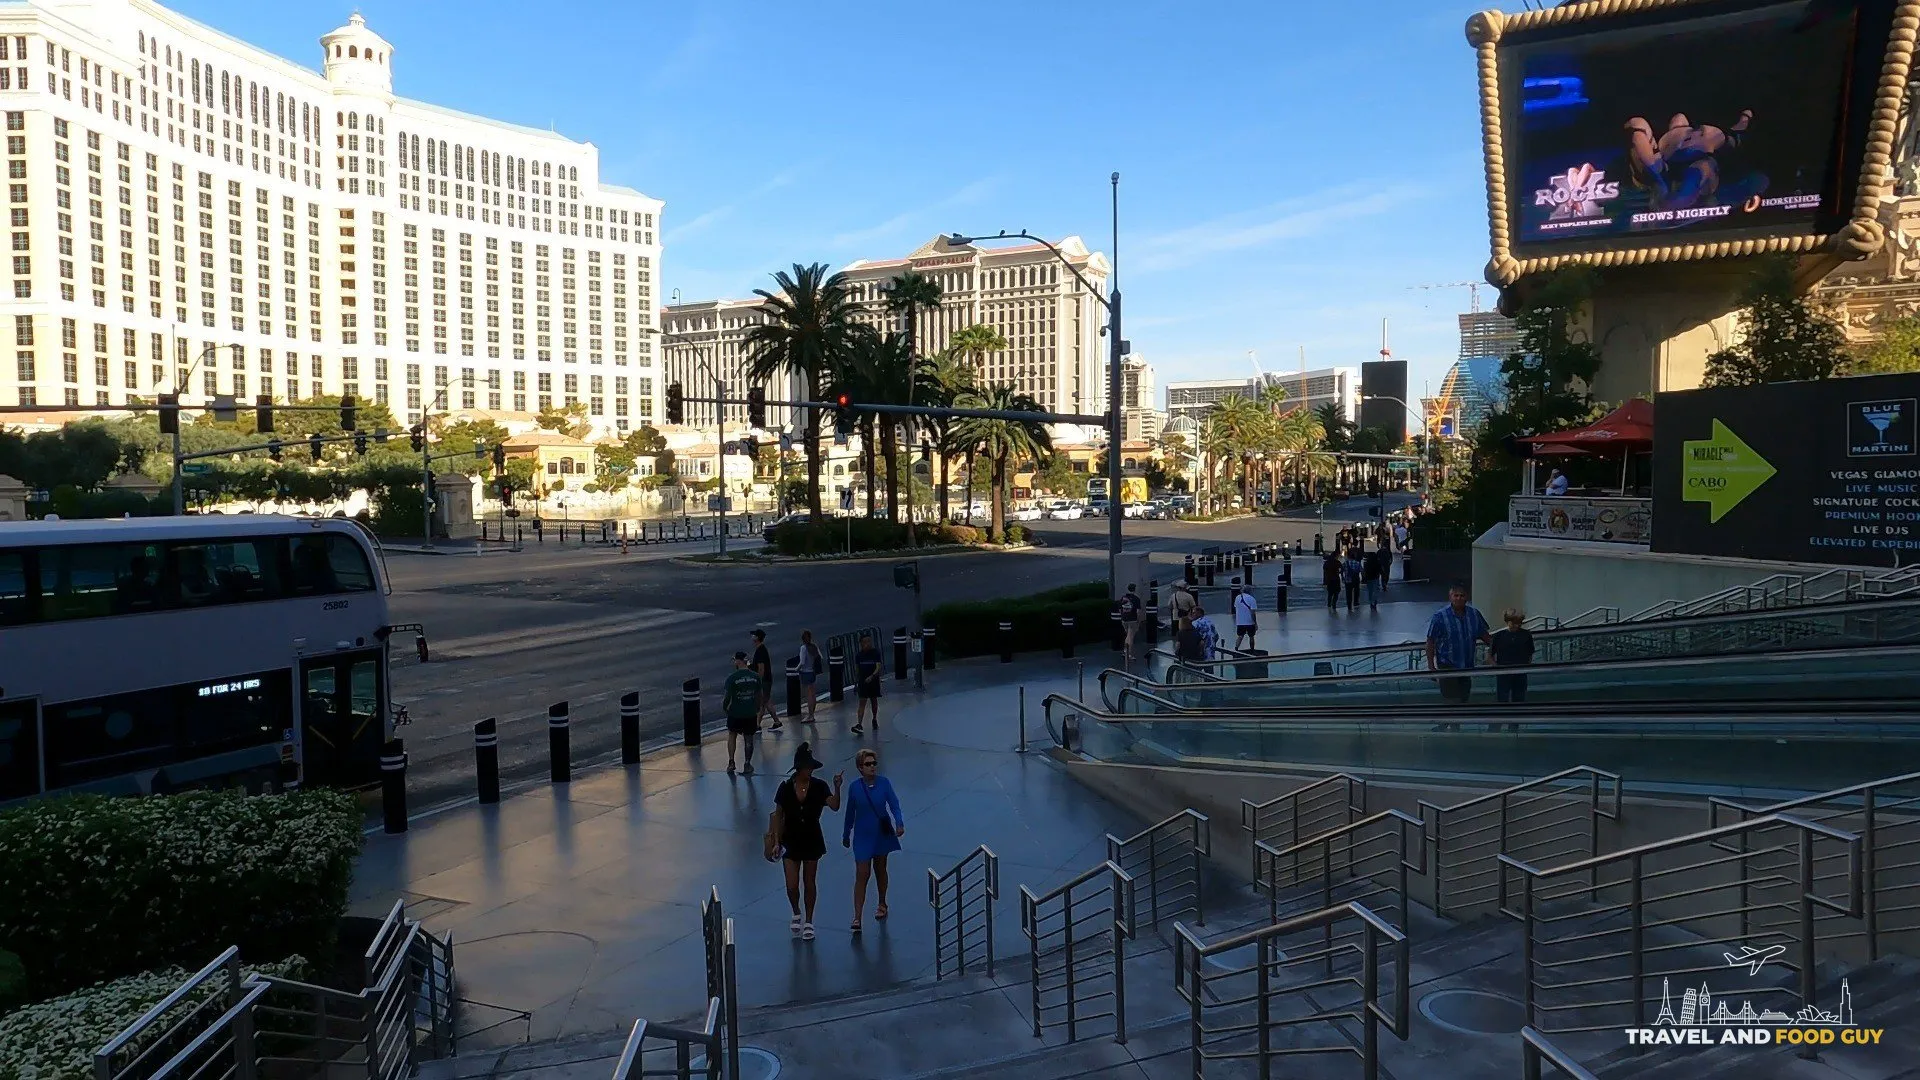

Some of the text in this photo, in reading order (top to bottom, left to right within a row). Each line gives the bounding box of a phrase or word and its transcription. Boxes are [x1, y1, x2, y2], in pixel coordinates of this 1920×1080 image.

[1535, 181, 1620, 206] ROCKS
[1761, 194, 1821, 207] HORSESHOE
[1632, 205, 1732, 223] SHOWS NIGHTLY
[1862, 404, 1901, 413] BLUE
[1693, 447, 1723, 460] MIRACLE
[1852, 445, 1908, 453] MARTINI
[1830, 470, 1920, 480] VEGAS GLAMO
[1688, 477, 1727, 488] CABO
[1846, 484, 1918, 492] LIVE MUSIC
[1813, 497, 1879, 506] SIGNATURE
[1825, 511, 1880, 520] PREMIUM
[1511, 521, 1547, 529] COCKTAILS
[1853, 525, 1909, 535] LIVE DJS
[1809, 536, 1920, 549] ELEVATED EXPERI
[212, 684, 229, 694] FOR
[230, 682, 242, 691] 24
